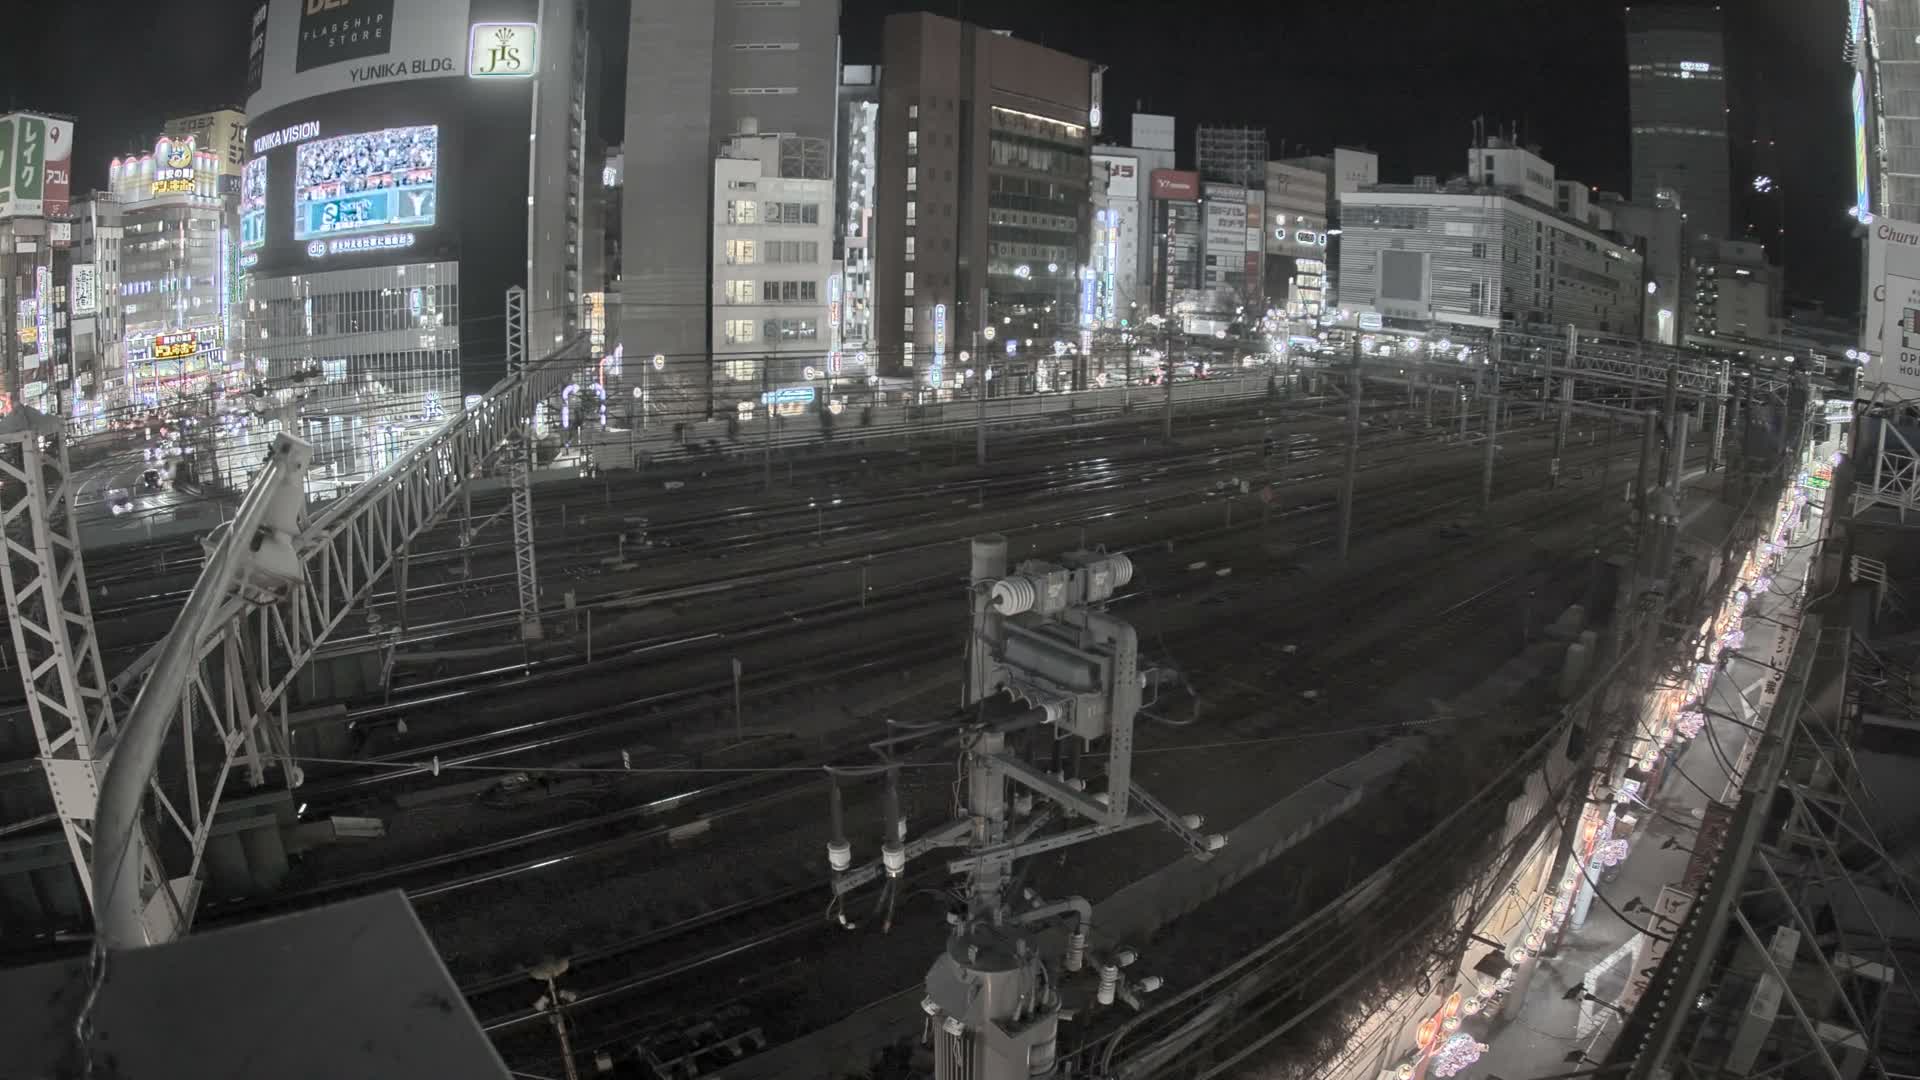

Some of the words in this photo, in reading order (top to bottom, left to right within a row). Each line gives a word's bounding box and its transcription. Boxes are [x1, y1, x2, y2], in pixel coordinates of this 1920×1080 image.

[303, 14, 383, 40] FLAGSHIP
[328, 28, 382, 47] STORE
[350, 63, 408, 82] YUNIKA
[412, 58, 456, 74] BLDG.
[253, 131, 281, 153] YUNIKA
[281, 120, 320, 144] VISION
[21, 121, 37, 188] レイク
[46, 169, 69, 185] アコム
[1877, 224, 1919, 246] Churu
[309, 241, 326, 255] dip
